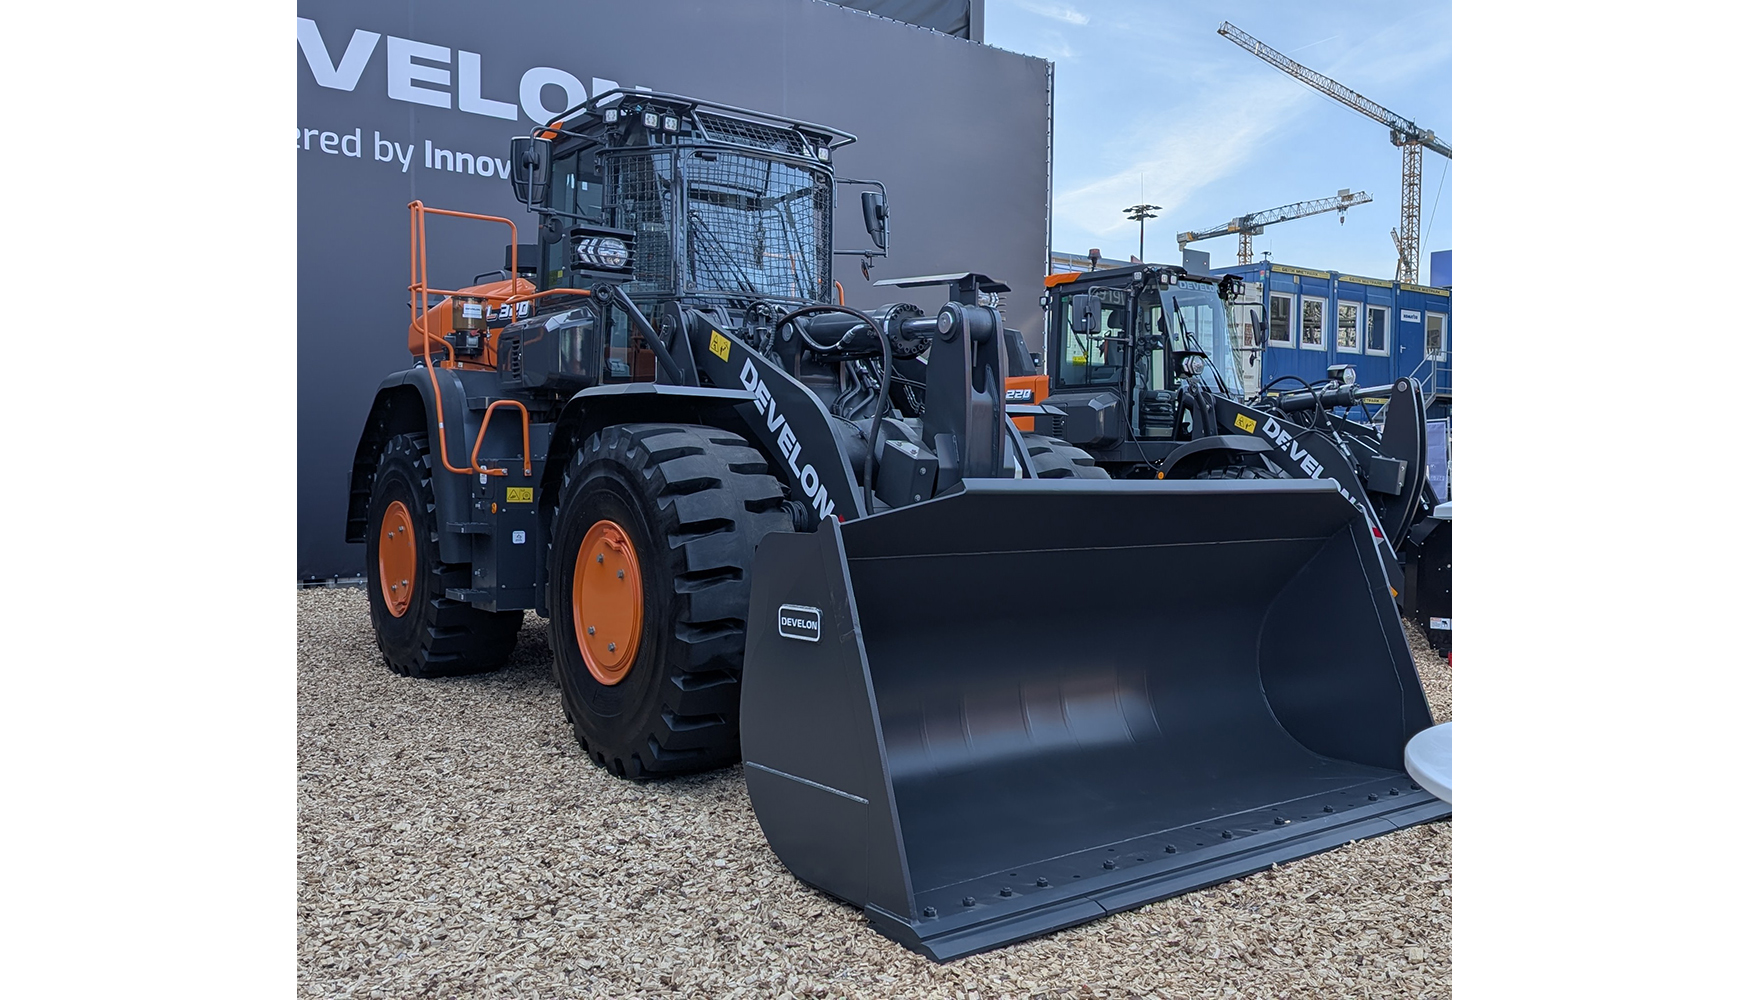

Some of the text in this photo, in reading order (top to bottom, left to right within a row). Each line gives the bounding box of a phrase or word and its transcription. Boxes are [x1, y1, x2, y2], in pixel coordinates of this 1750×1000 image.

[297, 127, 362, 158] red
[374, 131, 414, 173] by
[1179, 281, 1216, 293] DEVELO
[1006, 389, 1032, 401] 220
[739, 357, 836, 520] DEVELON
[781, 616, 818, 630] DEVELON
